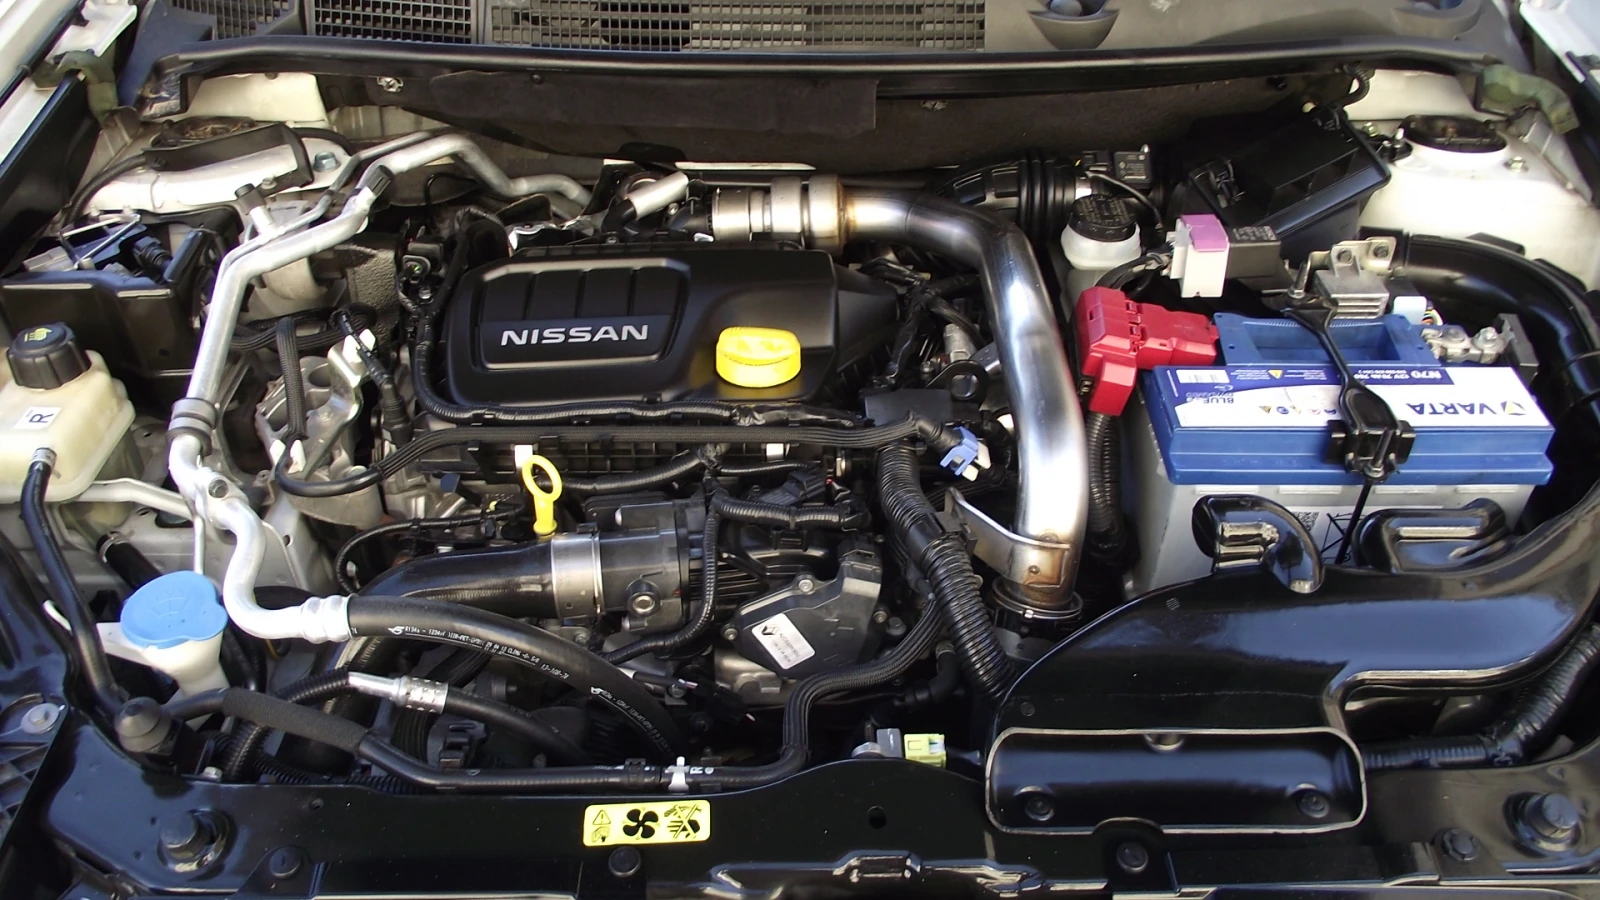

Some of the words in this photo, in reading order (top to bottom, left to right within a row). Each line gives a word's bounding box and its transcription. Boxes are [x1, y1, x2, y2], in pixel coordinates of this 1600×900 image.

[500, 324, 648, 346] NISSAN
[1406, 403, 1497, 415] VARTA
[29, 413, 54, 423] R
